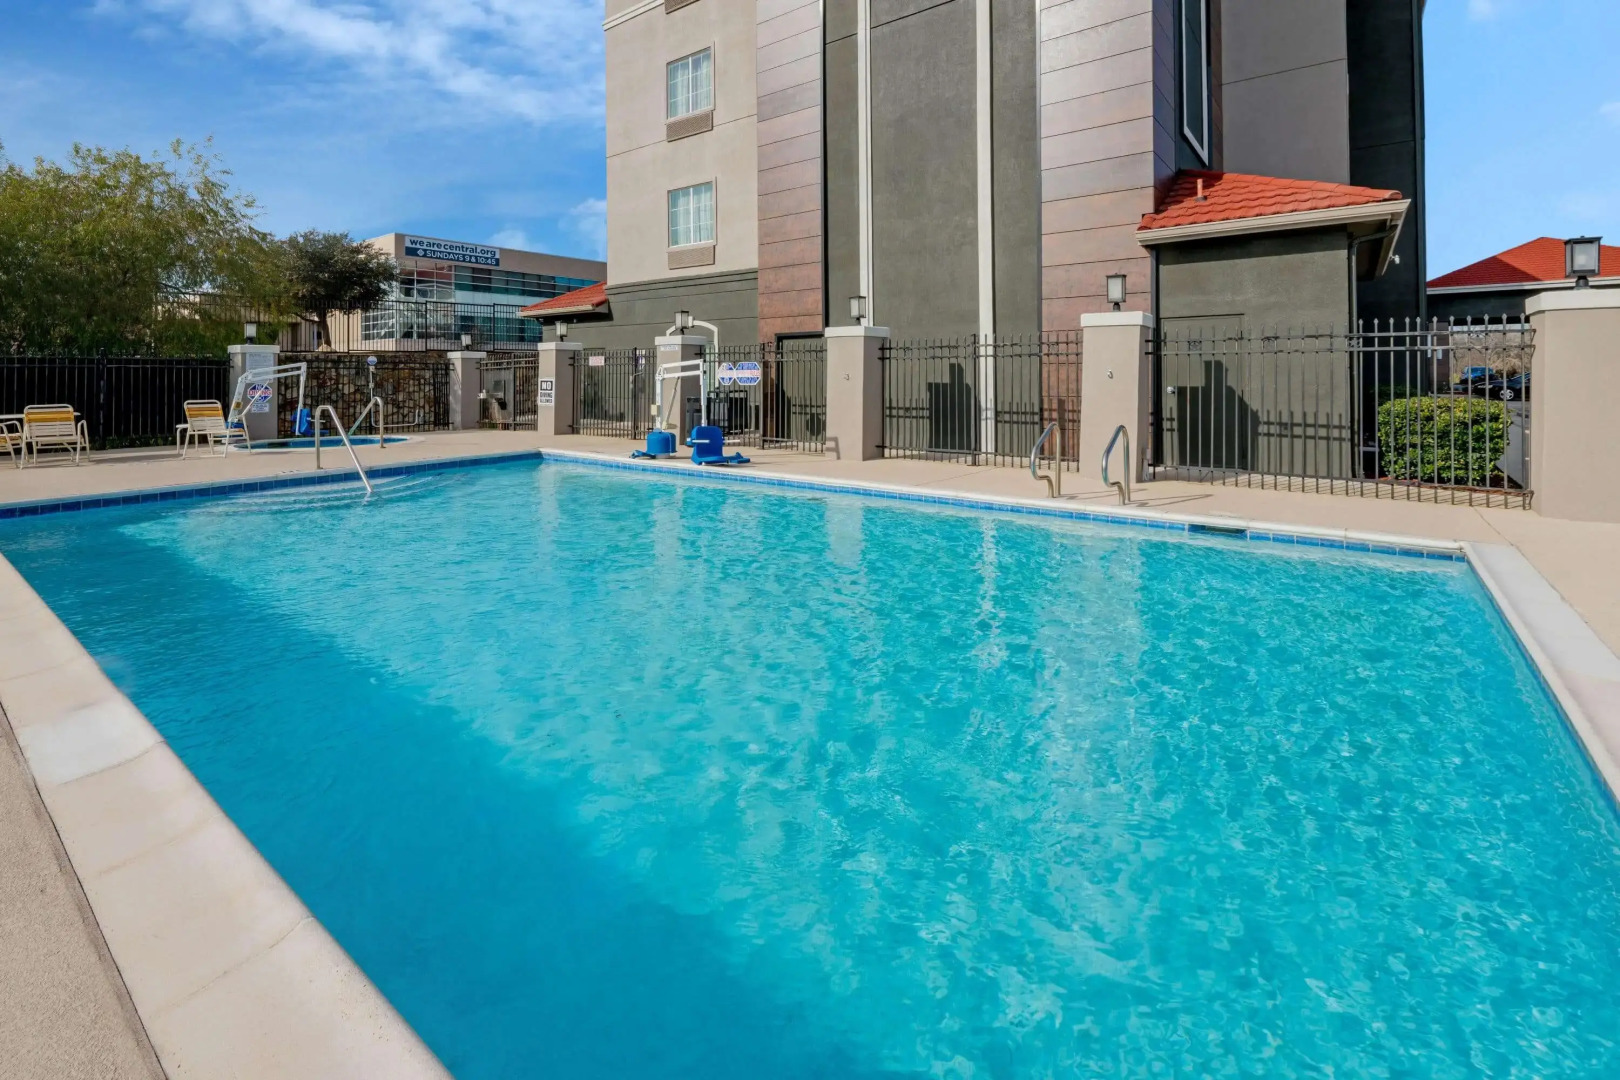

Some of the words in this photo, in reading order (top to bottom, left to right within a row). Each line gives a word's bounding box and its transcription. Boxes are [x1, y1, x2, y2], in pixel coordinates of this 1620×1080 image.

[426, 250, 463, 261] SUNDAYS
[477, 256, 496, 265] 10:45
[542, 382, 552, 390] NO
